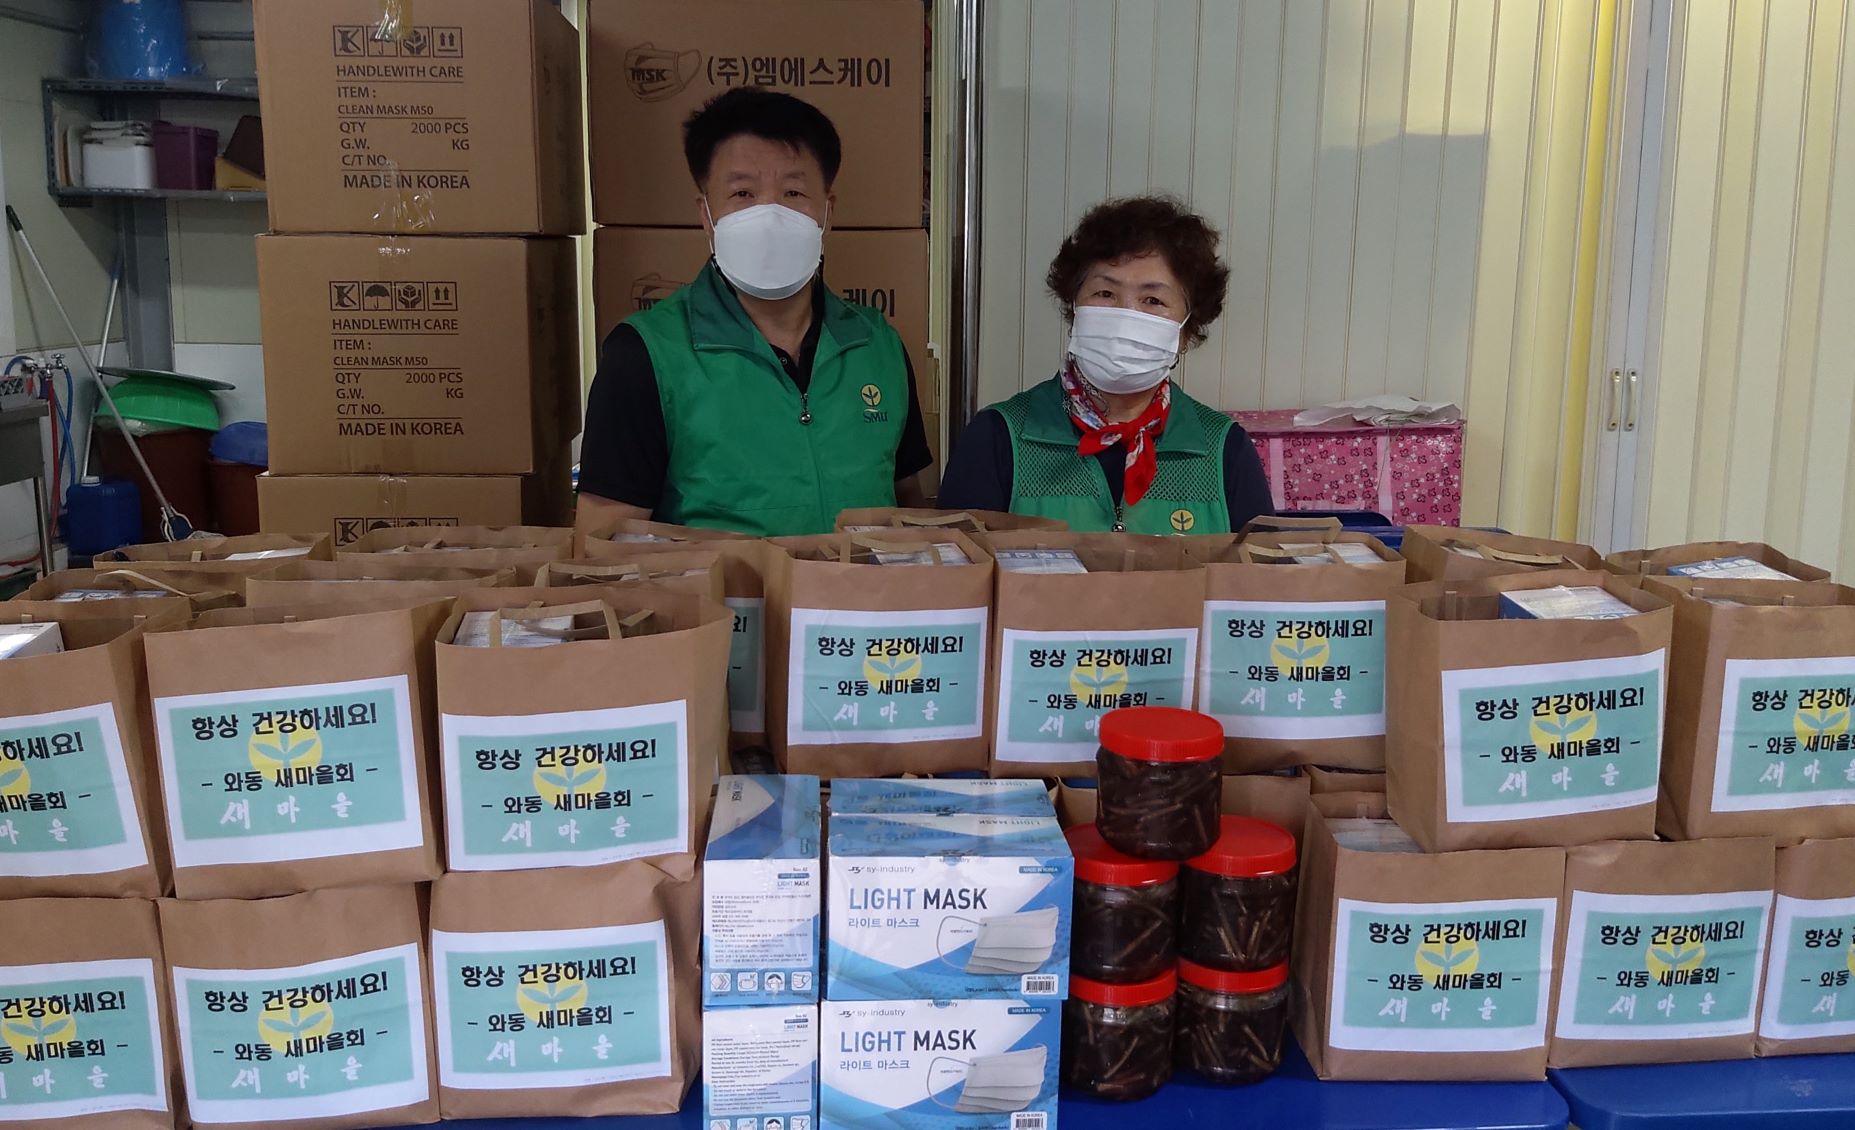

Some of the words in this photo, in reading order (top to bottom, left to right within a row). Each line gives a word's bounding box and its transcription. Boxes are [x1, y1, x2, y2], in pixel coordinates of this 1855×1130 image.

[429, 65, 463, 78] CARE
[631, 68, 667, 83] MSK
[706, 57, 891, 87] (주)엠에스케이
[338, 105, 373, 115] CLEAN
[376, 105, 408, 115] MASK
[410, 105, 433, 115] M50
[340, 122, 366, 135] QTY
[411, 122, 441, 134] 2000
[445, 122, 469, 134] PCS
[341, 138, 370, 150] G.W.
[452, 139, 469, 151] KG
[342, 154, 364, 166] C/T
[367, 154, 390, 166] NO.
[344, 175, 392, 189] MADE
[396, 175, 412, 189] IN
[417, 174, 470, 189] KOREA
[424, 319, 458, 330] CARE
[334, 356, 369, 366] CLEAN
[371, 356, 402, 366] MASK
[404, 356, 428, 366] M50
[335, 373, 361, 384] QTY
[405, 373, 436, 383] 2000
[439, 373, 463, 383] PCS
[336, 389, 365, 399] G.W.
[446, 388, 464, 399] KG
[337, 404, 358, 415] C/T
[361, 404, 384, 415] NO.
[339, 423, 386, 435] MADE
[390, 423, 406, 435] IN
[410, 422, 464, 435] KOREA
[1228, 619, 1265, 638] 항상
[1276, 619, 1373, 639] 건강하세요!
[818, 637, 855, 657] 항상
[865, 635, 963, 656] 건강하세요!
[1029, 649, 1066, 668] 항상
[1076, 647, 1172, 668] 건강하세요!
[1247, 665, 1279, 682] 와동
[1288, 665, 1351, 682] 새마을회
[837, 680, 868, 697] 와동
[878, 677, 940, 695] 새마을회
[1046, 694, 1077, 710] 와동
[1086, 692, 1147, 710] 새마을회
[1475, 698, 1519, 721] 항상
[1531, 687, 1644, 717] 건강하세요!
[1751, 690, 1788, 712] 항상
[1798, 687, 1855, 709] 건강하
[192, 714, 239, 740] 항상
[252, 702, 377, 735] 건강하세요!
[0, 731, 84, 761] 하세요!
[475, 749, 522, 770] 항상
[535, 738, 657, 768] 건강하세요!
[1500, 744, 1537, 763] 와동
[1548, 737, 1620, 760] 새마을회
[1766, 736, 1797, 755] 와동
[224, 770, 263, 792] 와동
[274, 762, 355, 788] 새마을회
[503, 796, 542, 814] 와동
[554, 789, 632, 812] 새마을회
[850, 888, 916, 910] LIGHT
[923, 888, 988, 910] MASK
[849, 917, 881, 929] 라이트
[886, 917, 920, 928] 마스크
[1368, 922, 1411, 944] 항상
[1422, 919, 1527, 944] 건강하세요!
[1600, 925, 1641, 945] 항상
[1650, 920, 1744, 945] 건강하세요!
[1804, 928, 1842, 948] 항상
[461, 966, 505, 988] 항상
[518, 956, 637, 985] 건강하세요!
[1388, 974, 1423, 991] 와동
[1433, 972, 1502, 991] 새마을회
[1615, 970, 1649, 988] 와동
[1657, 967, 1719, 987] 새마을회
[1819, 969, 1849, 987] 와동
[205, 990, 248, 1012] 항상
[262, 971, 388, 1012] 건강하세요!
[0, 991, 126, 1019] 건강하세요!
[488, 1013, 525, 1032] 와동
[537, 1005, 612, 1029] 새마을회
[25, 1038, 106, 1062] 새마을회
[234, 1043, 272, 1061] 와동
[284, 1028, 365, 1059] 새마을회
[841, 1031, 906, 1052] LIGHT
[913, 1029, 976, 1051] MASK
[840, 1060, 872, 1071] 라이트
[877, 1059, 910, 1070] 마스크
